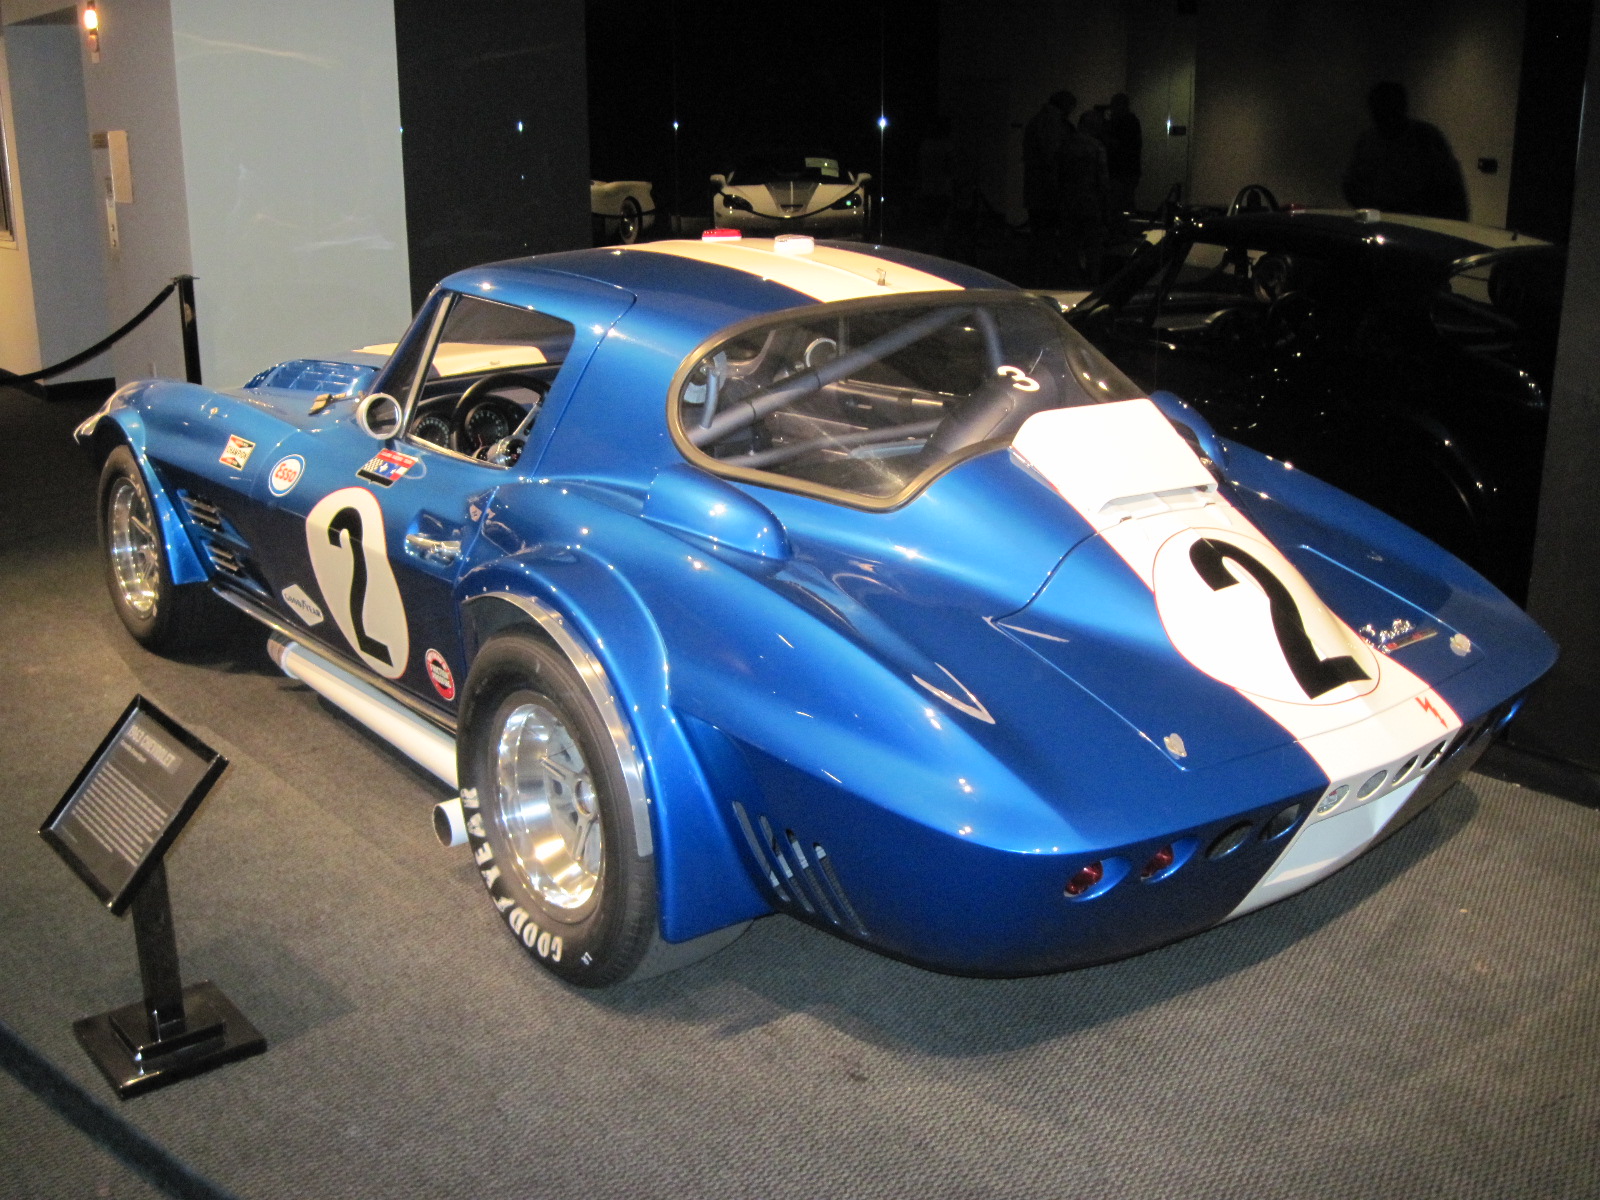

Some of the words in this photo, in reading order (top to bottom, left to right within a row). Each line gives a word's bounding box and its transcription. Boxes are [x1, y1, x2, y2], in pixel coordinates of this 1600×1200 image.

[226, 445, 249, 461] CHAMPION
[997, 365, 1040, 392] 3
[328, 506, 393, 667] 2
[1189, 537, 1372, 700] 2
[460, 787, 563, 962] GOODYEAR
